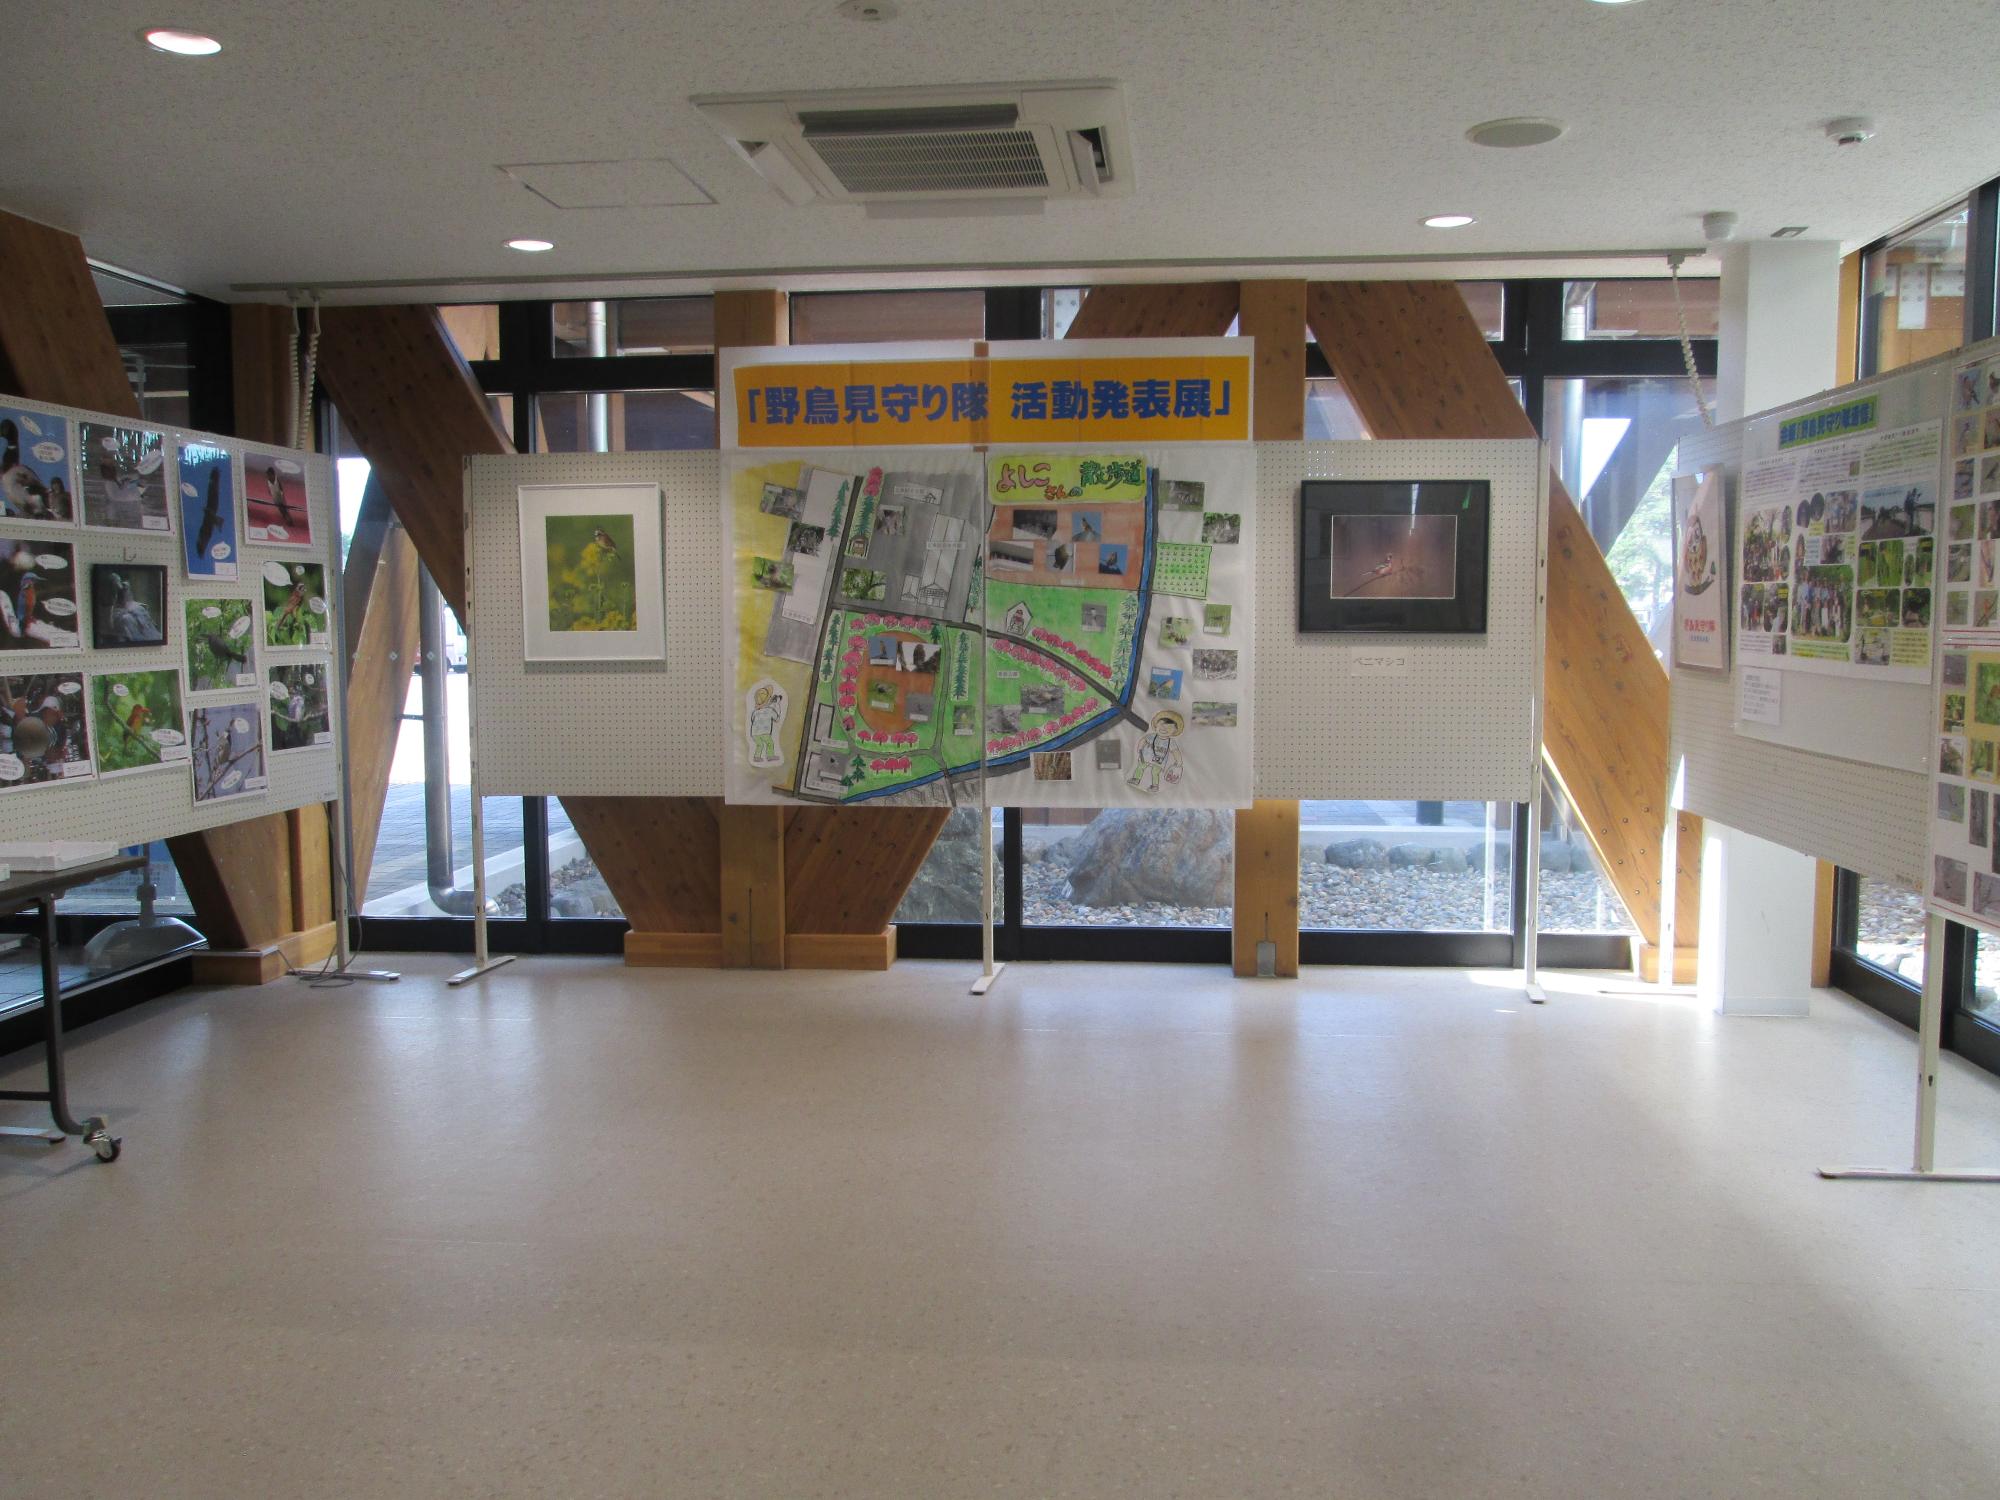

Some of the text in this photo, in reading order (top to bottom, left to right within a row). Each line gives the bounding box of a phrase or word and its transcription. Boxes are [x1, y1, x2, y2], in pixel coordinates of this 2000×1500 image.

[747, 379, 1231, 425] 「野鳥見守り隊 活動発表展」
[1080, 459, 1146, 490] 散歩道
